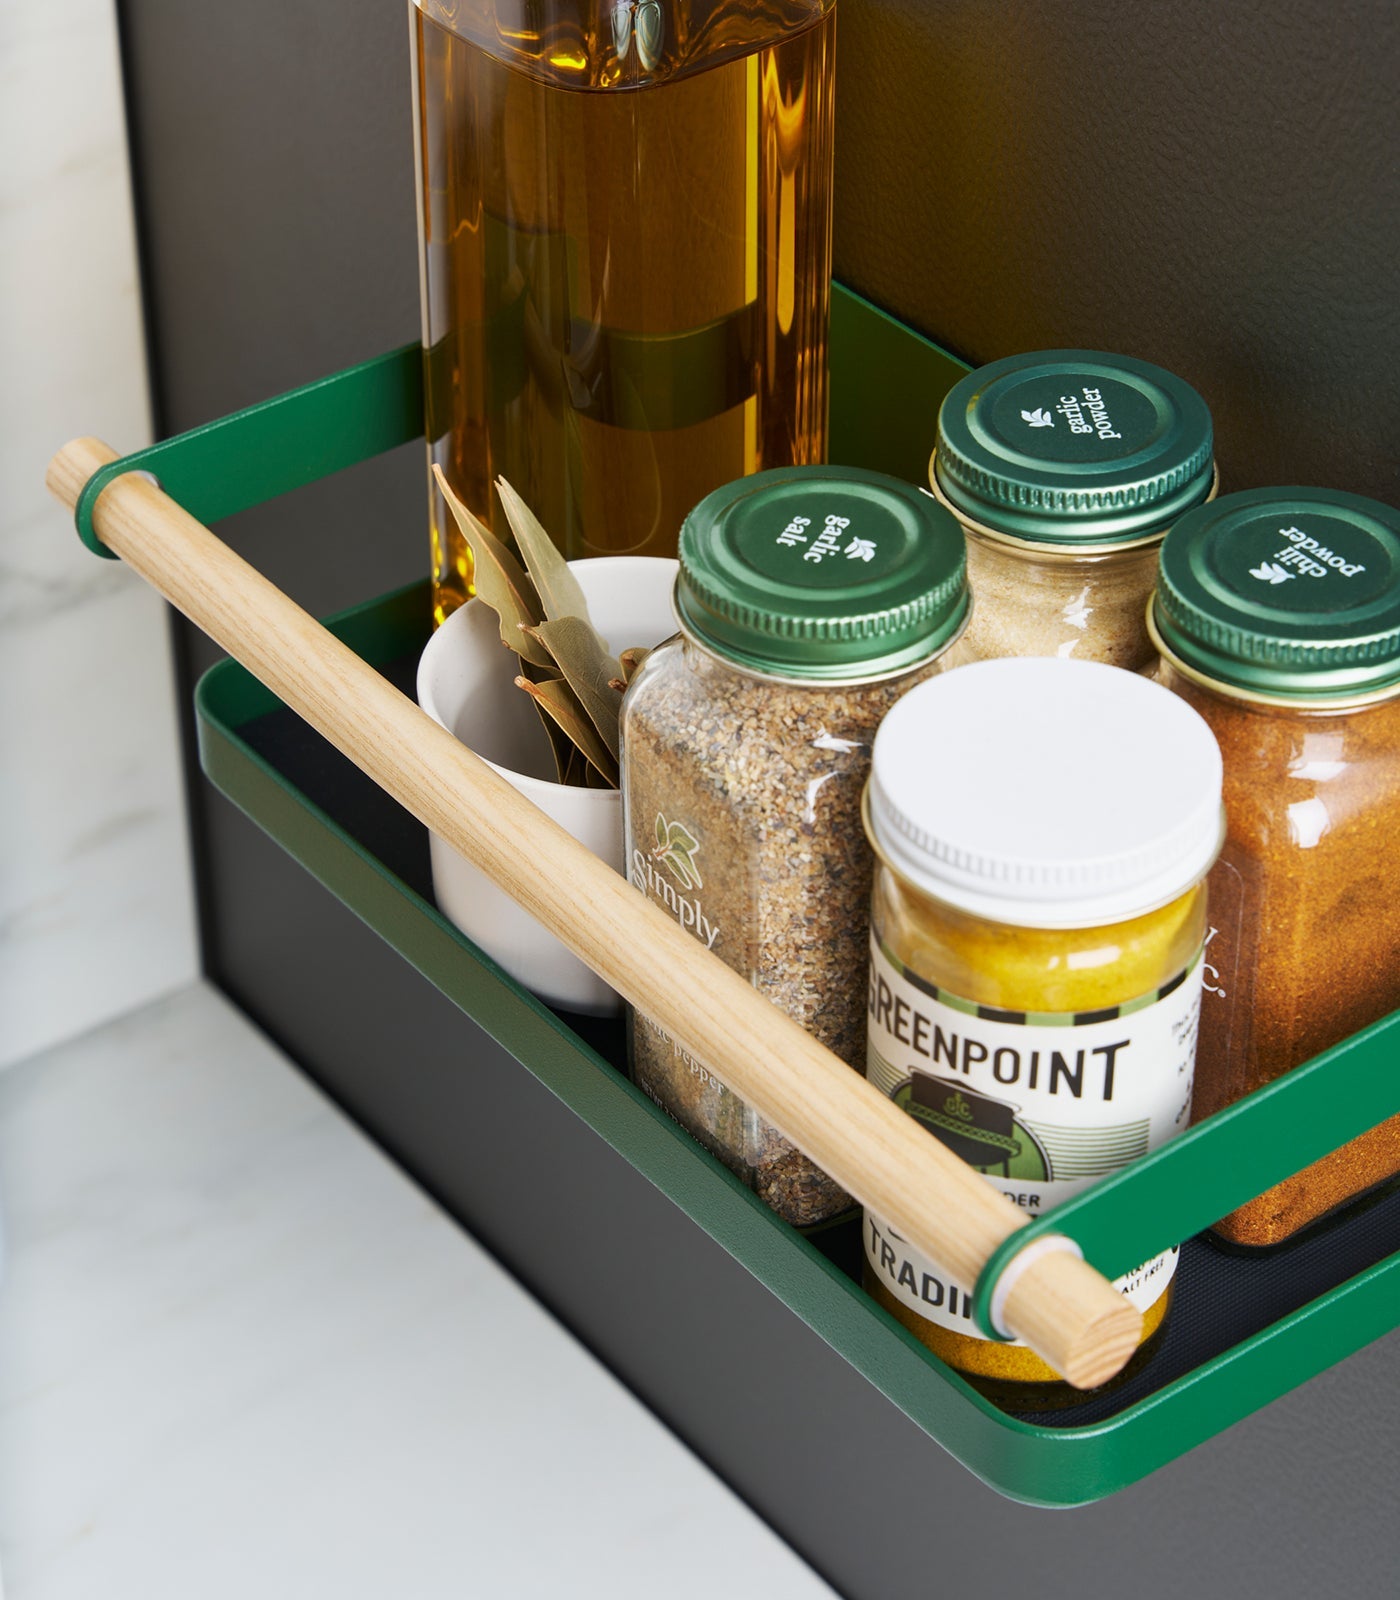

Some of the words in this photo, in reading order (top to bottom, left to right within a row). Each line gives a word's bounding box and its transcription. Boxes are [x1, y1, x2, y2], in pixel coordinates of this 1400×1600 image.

[1055, 396, 1094, 434] garlic
[1081, 387, 1122, 440] powder
[775, 516, 812, 547] salt
[803, 514, 851, 563] garlic
[1278, 526, 1366, 578] powder
[1273, 545, 1328, 578] chili
[632, 849, 720, 949] Simply
[673, 1041, 726, 1097] pepper
[1003, 1191, 1041, 1208] DER
[1121, 1276, 1141, 1295] ALT
